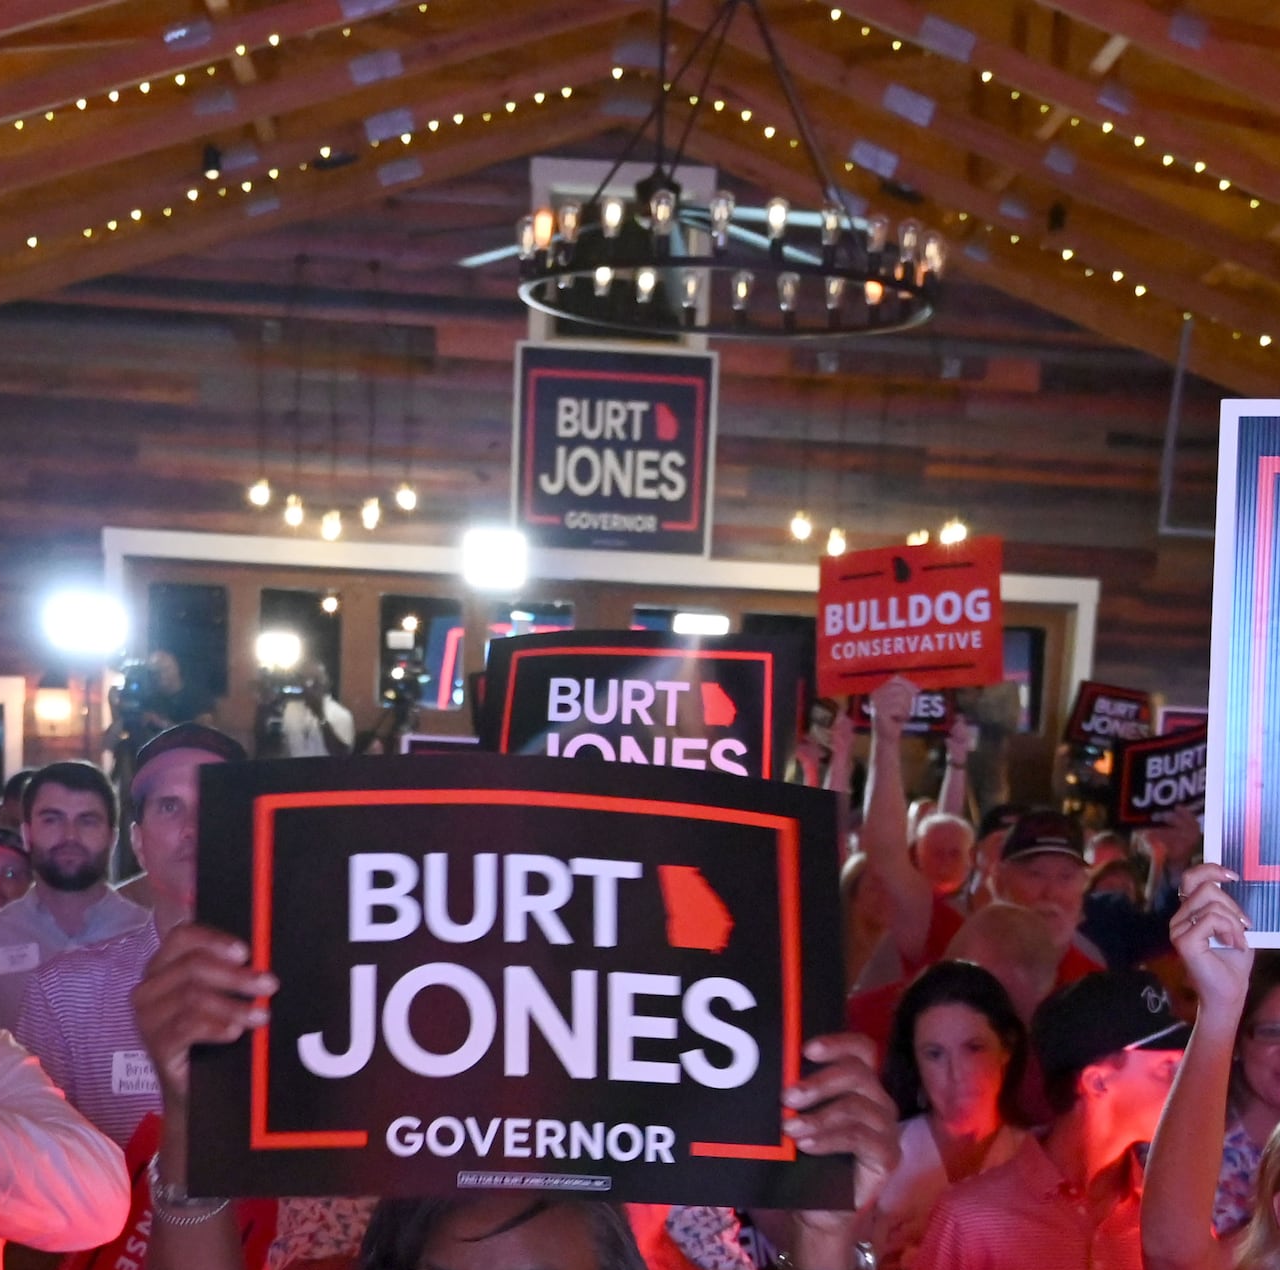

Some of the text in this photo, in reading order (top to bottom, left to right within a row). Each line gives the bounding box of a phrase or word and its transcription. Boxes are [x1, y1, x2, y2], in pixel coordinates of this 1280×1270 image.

[557, 397, 650, 441] BURT
[539, 445, 687, 501] JONES
[564, 510, 658, 533] GOVERNOR
[824, 588, 991, 636] BULLDOG
[831, 630, 982, 660] CONSERVATIVE
[547, 677, 690, 727] BURT
[1094, 697, 1140, 720] BURT
[1131, 767, 1207, 808] JONE
[349, 852, 643, 949] BURT
[296, 962, 760, 1090] JONES
[385, 1115, 676, 1164] GOVERNOR
